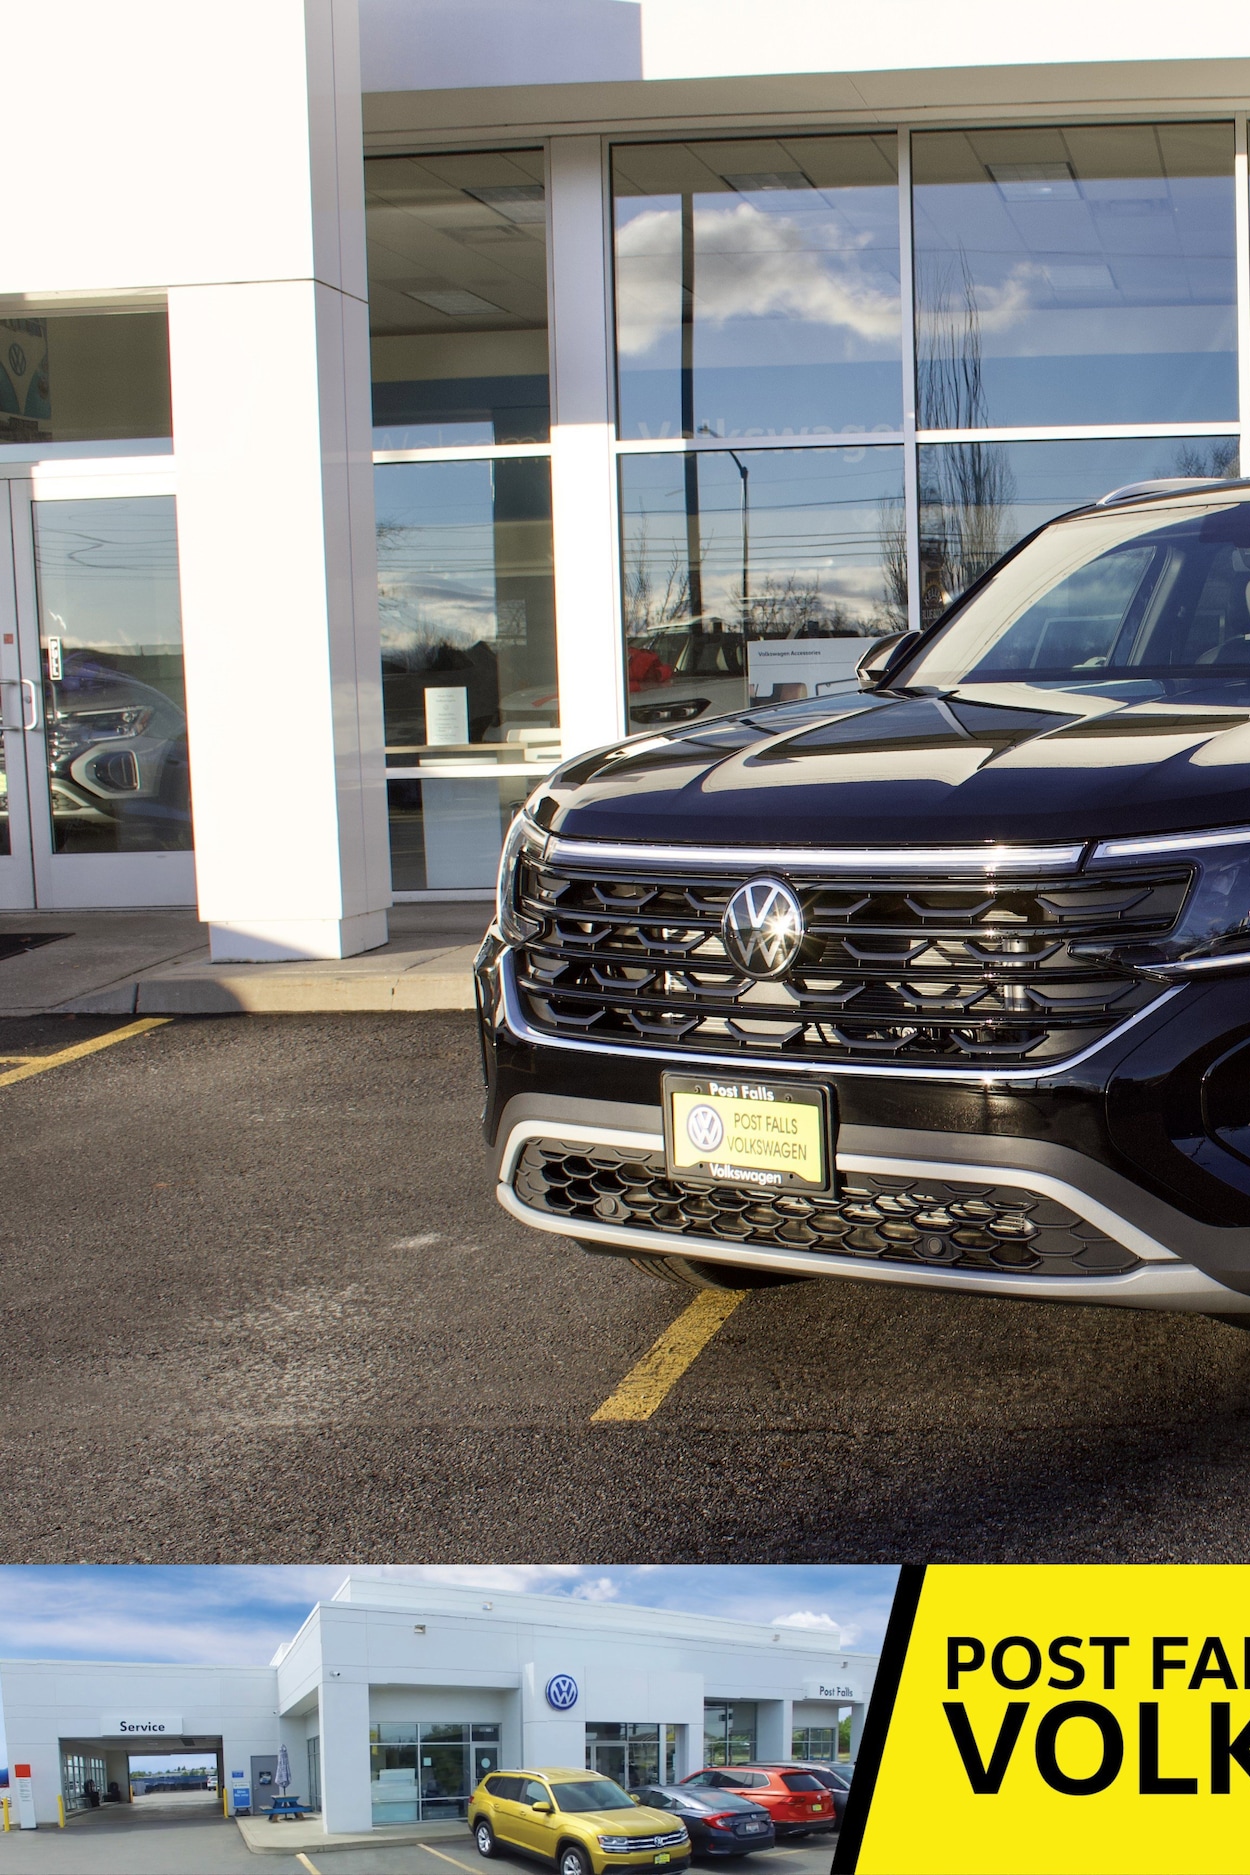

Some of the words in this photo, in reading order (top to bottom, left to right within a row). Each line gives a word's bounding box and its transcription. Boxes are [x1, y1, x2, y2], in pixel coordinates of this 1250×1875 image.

[638, 418, 904, 463] Vlkswage
[709, 1082, 739, 1098] Post
[741, 1085, 775, 1101] Falls
[734, 1112, 762, 1130] POST
[765, 1115, 798, 1135] FALLS
[727, 1135, 807, 1161] VOLKSWAGEN
[709, 1162, 782, 1185] Volkswagen
[819, 1685, 835, 1696] Post
[836, 1686, 853, 1697] Falls
[120, 1720, 165, 1732] Service
